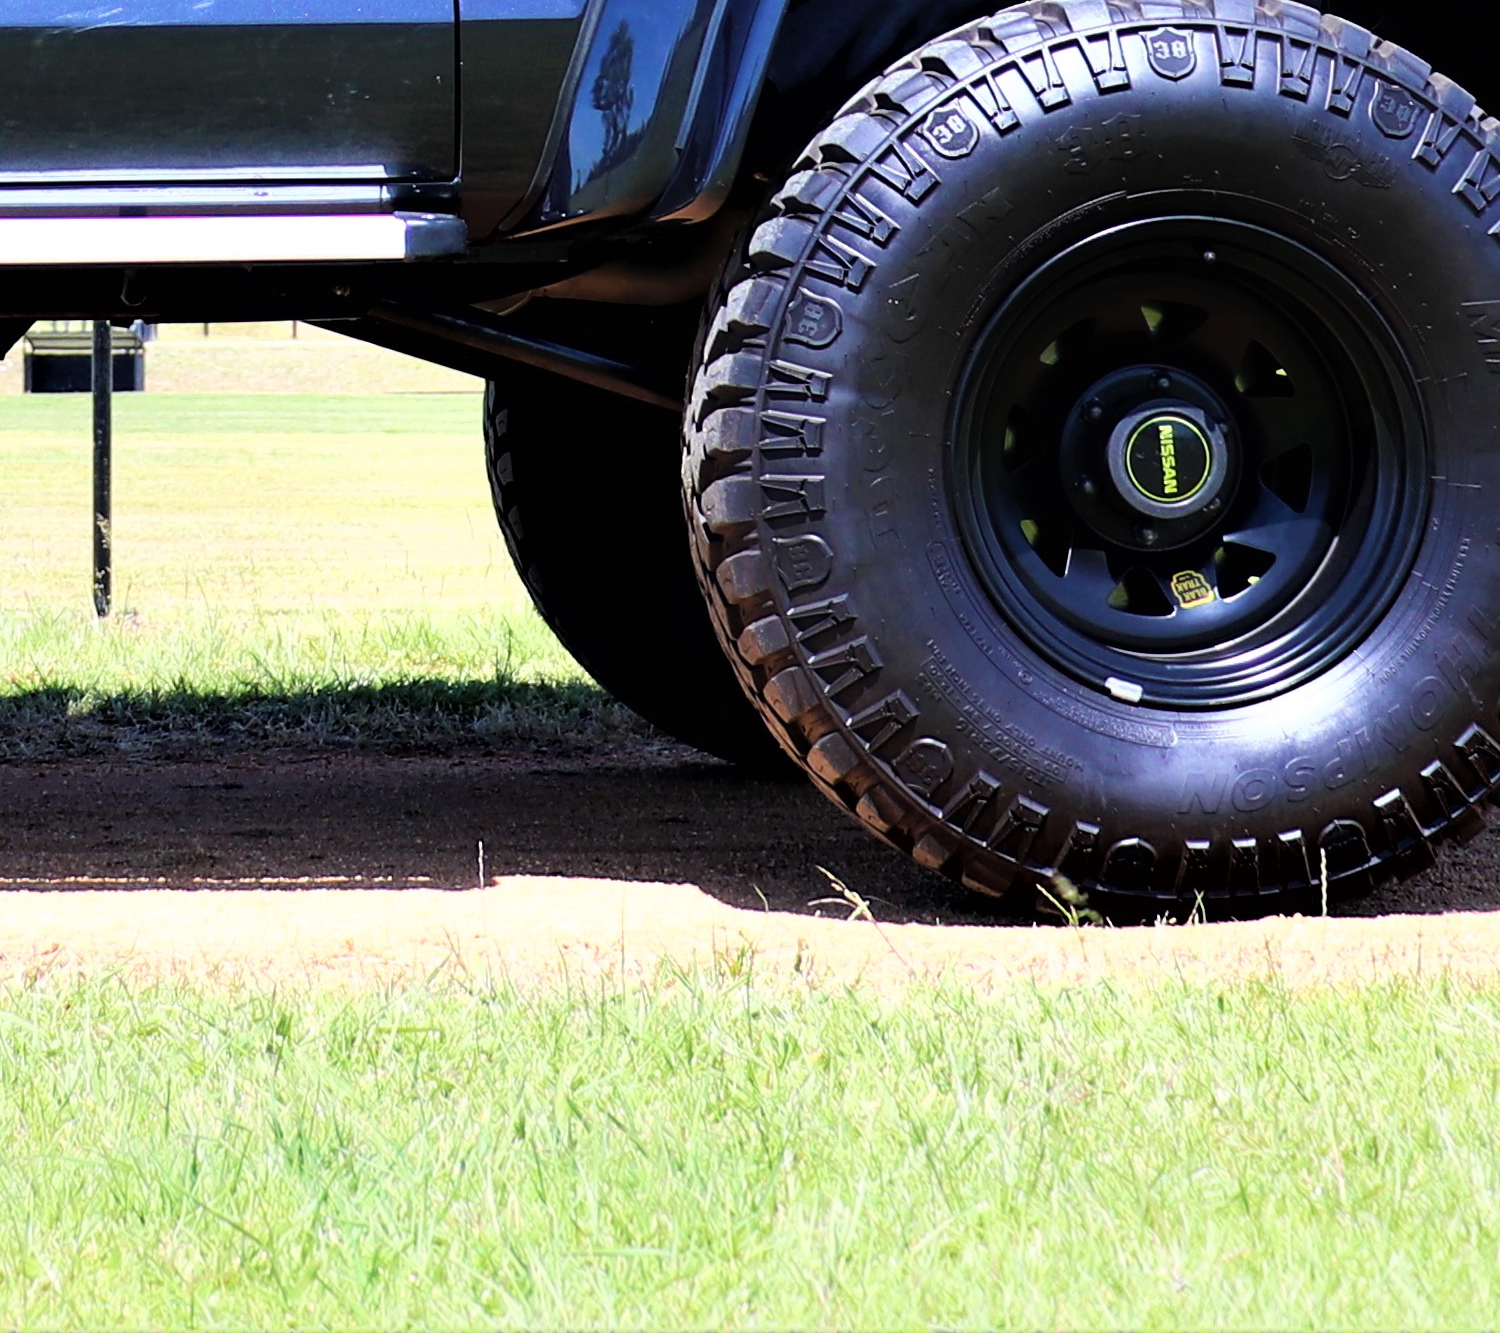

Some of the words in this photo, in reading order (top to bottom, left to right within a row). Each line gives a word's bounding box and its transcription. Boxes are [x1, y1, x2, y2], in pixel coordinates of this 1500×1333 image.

[1152, 39, 1187, 61] 38
[1376, 91, 1418, 130] 38
[929, 112, 968, 148] 38
[794, 299, 826, 337] 38
[1158, 425, 1178, 493] NISSAN
